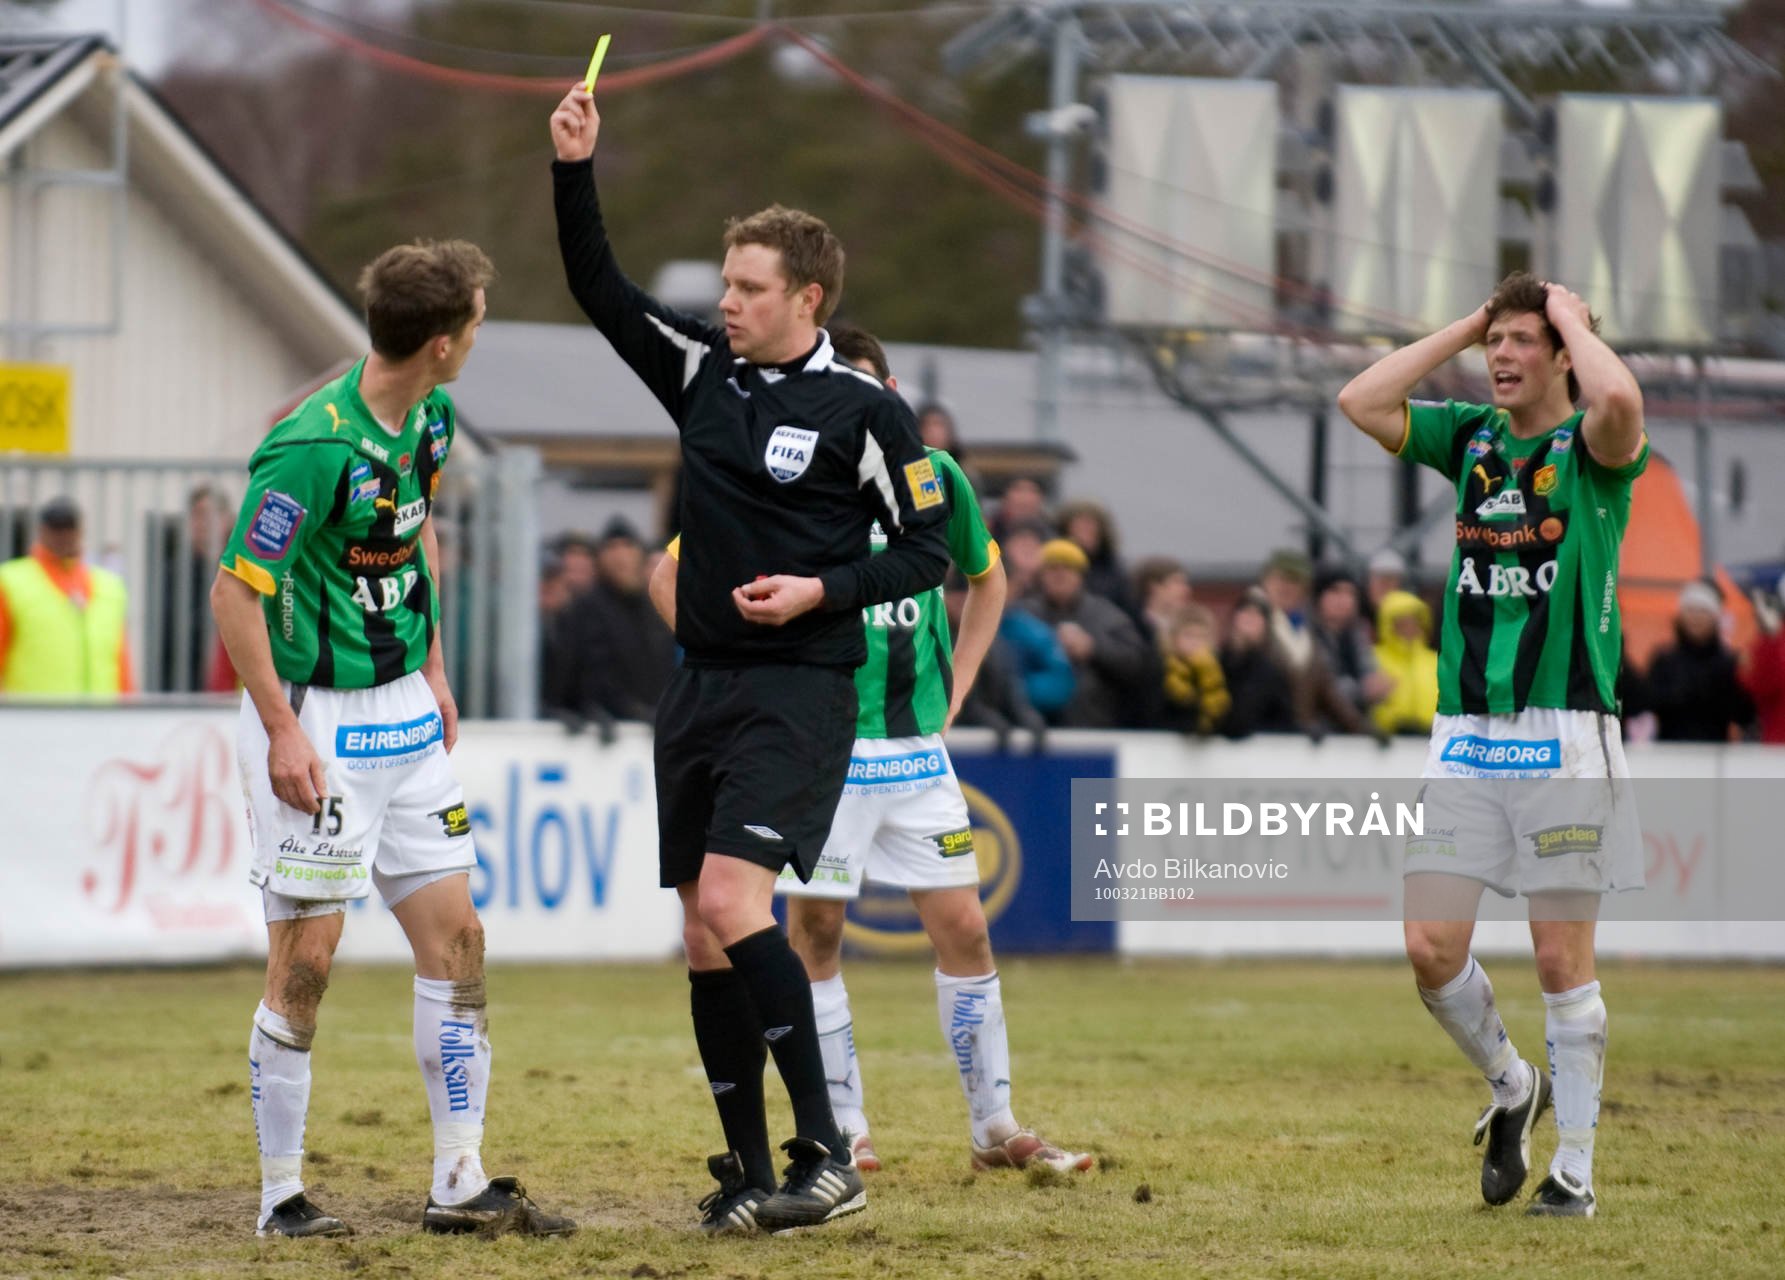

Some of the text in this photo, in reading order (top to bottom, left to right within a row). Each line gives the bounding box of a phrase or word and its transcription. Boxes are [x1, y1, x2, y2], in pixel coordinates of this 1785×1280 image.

[775, 430, 813, 442] REFEREE
[771, 445, 805, 462] FIFA
[1485, 493, 1521, 509] SAB
[1456, 556, 1559, 597] ÅBRO
[862, 597, 920, 627] RO
[311, 796, 343, 836] 15
[279, 834, 307, 854] Åke
[275, 860, 347, 881] Byggnads
[951, 991, 988, 1074] Folksam
[440, 1021, 475, 1112] Folksam
